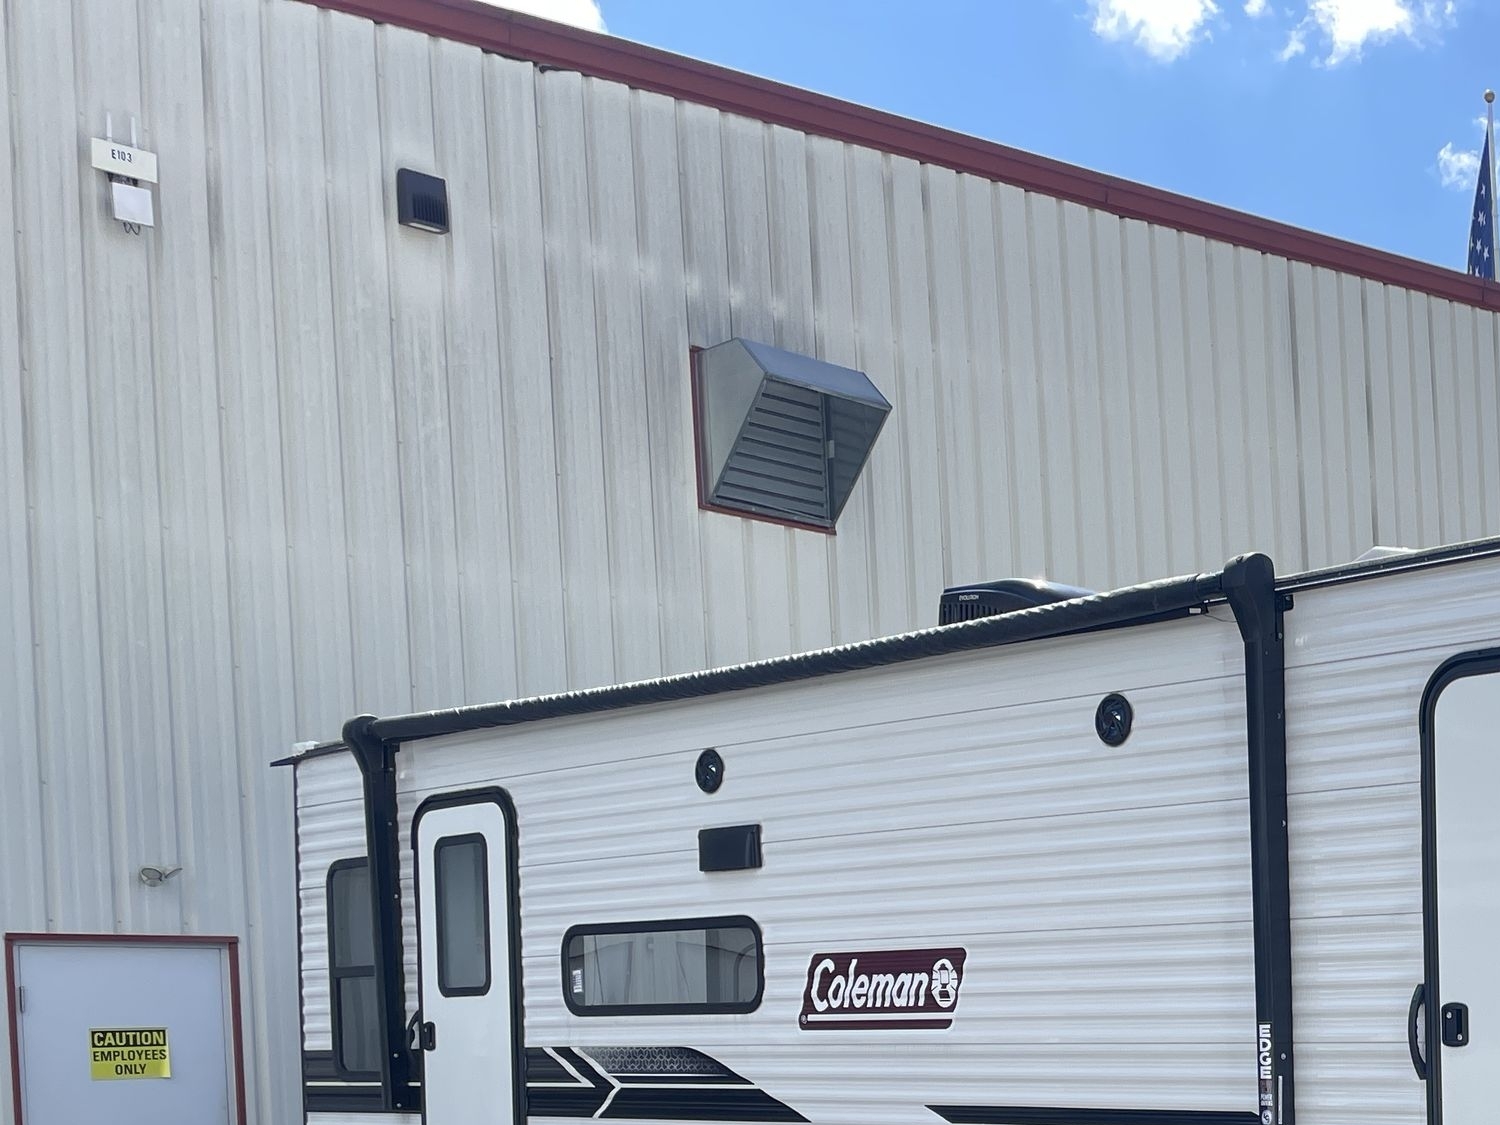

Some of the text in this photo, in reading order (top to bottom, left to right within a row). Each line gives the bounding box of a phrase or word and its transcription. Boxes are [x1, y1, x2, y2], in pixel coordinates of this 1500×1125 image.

[111, 148, 132, 163] E103
[810, 958, 930, 1012] Coleman
[93, 1031, 165, 1047] CAUTION
[93, 1049, 167, 1062] EMPLOYEES
[1258, 1023, 1273, 1080] EDGE
[115, 1063, 147, 1076] ONLY
